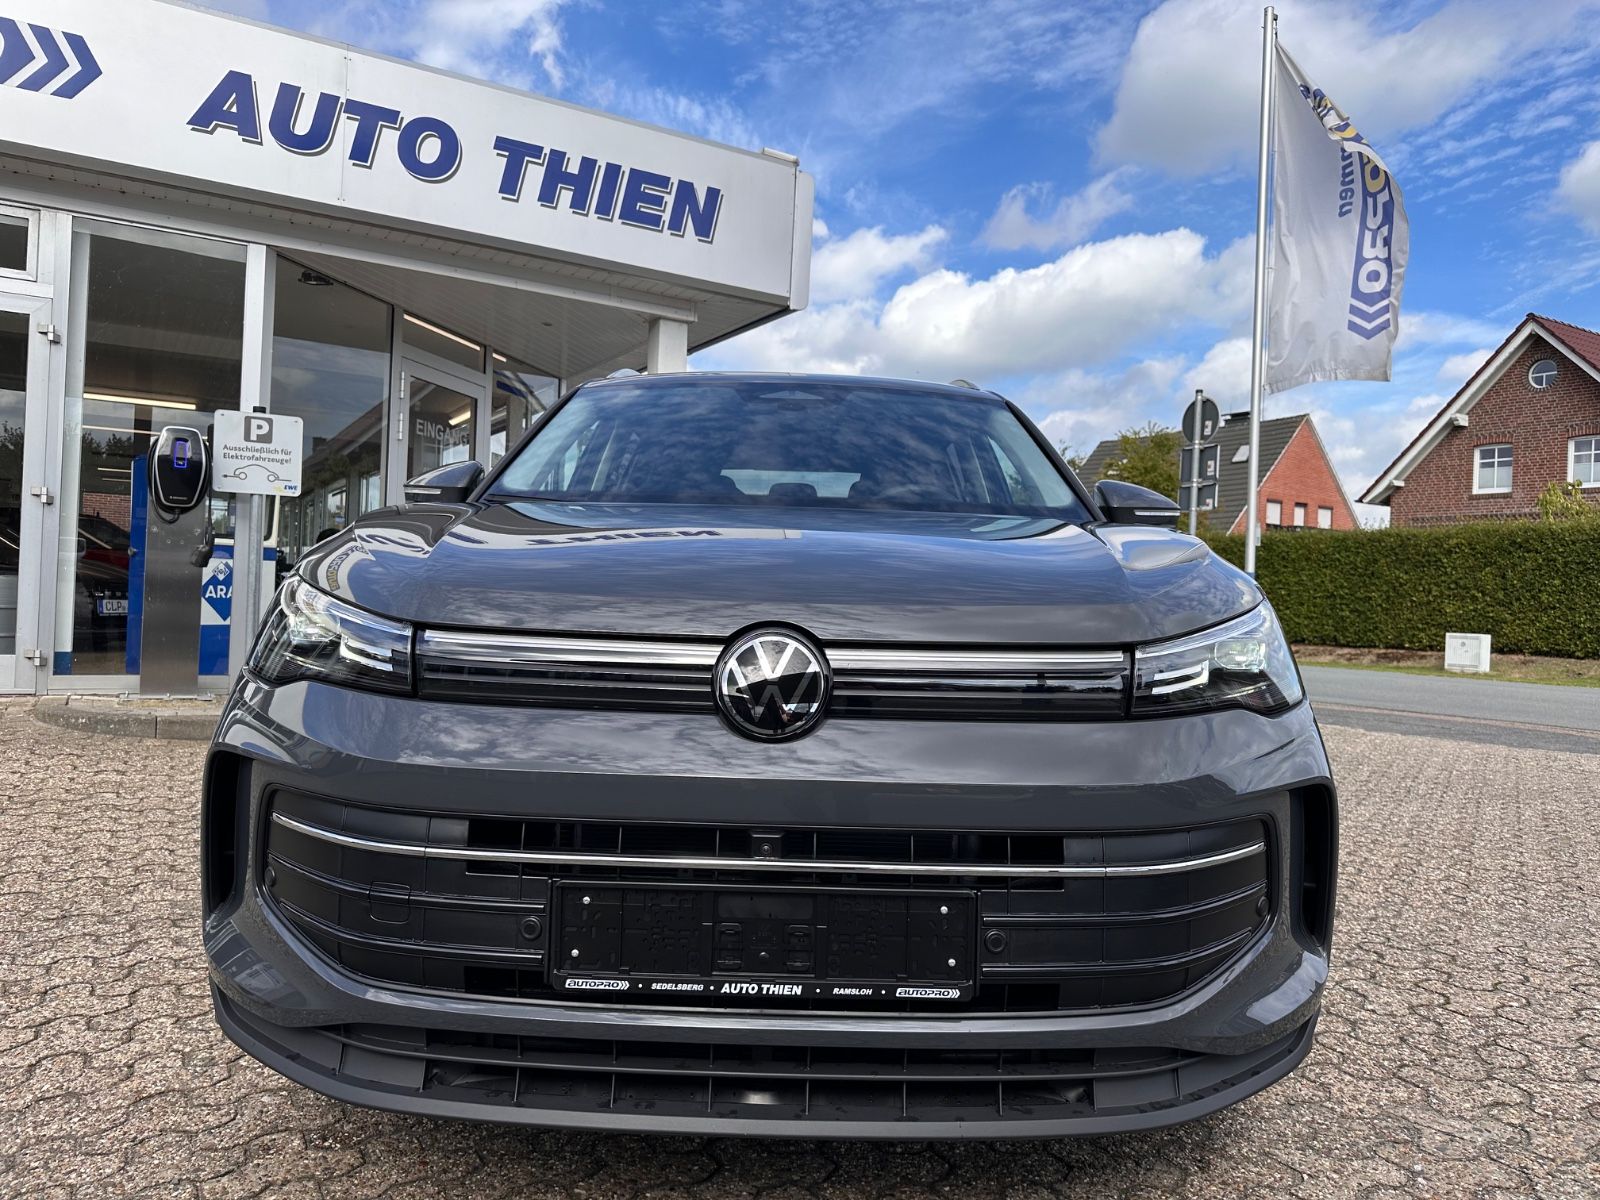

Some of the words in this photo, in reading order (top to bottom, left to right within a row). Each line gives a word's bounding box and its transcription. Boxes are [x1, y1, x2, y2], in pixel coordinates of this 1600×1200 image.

[186, 69, 462, 184] AUTO
[493, 135, 723, 244] THIEN
[249, 418, 270, 441] P
[416, 418, 470, 447] EINGANG
[223, 444, 279, 455] Ausschließlich
[280, 448, 292, 456] für
[223, 453, 292, 464] Elektrofahrzeuge!
[651, 982, 704, 991] SEDELSBERG
[720, 983, 759, 994] AUTO
[760, 983, 802, 995] THIEN
